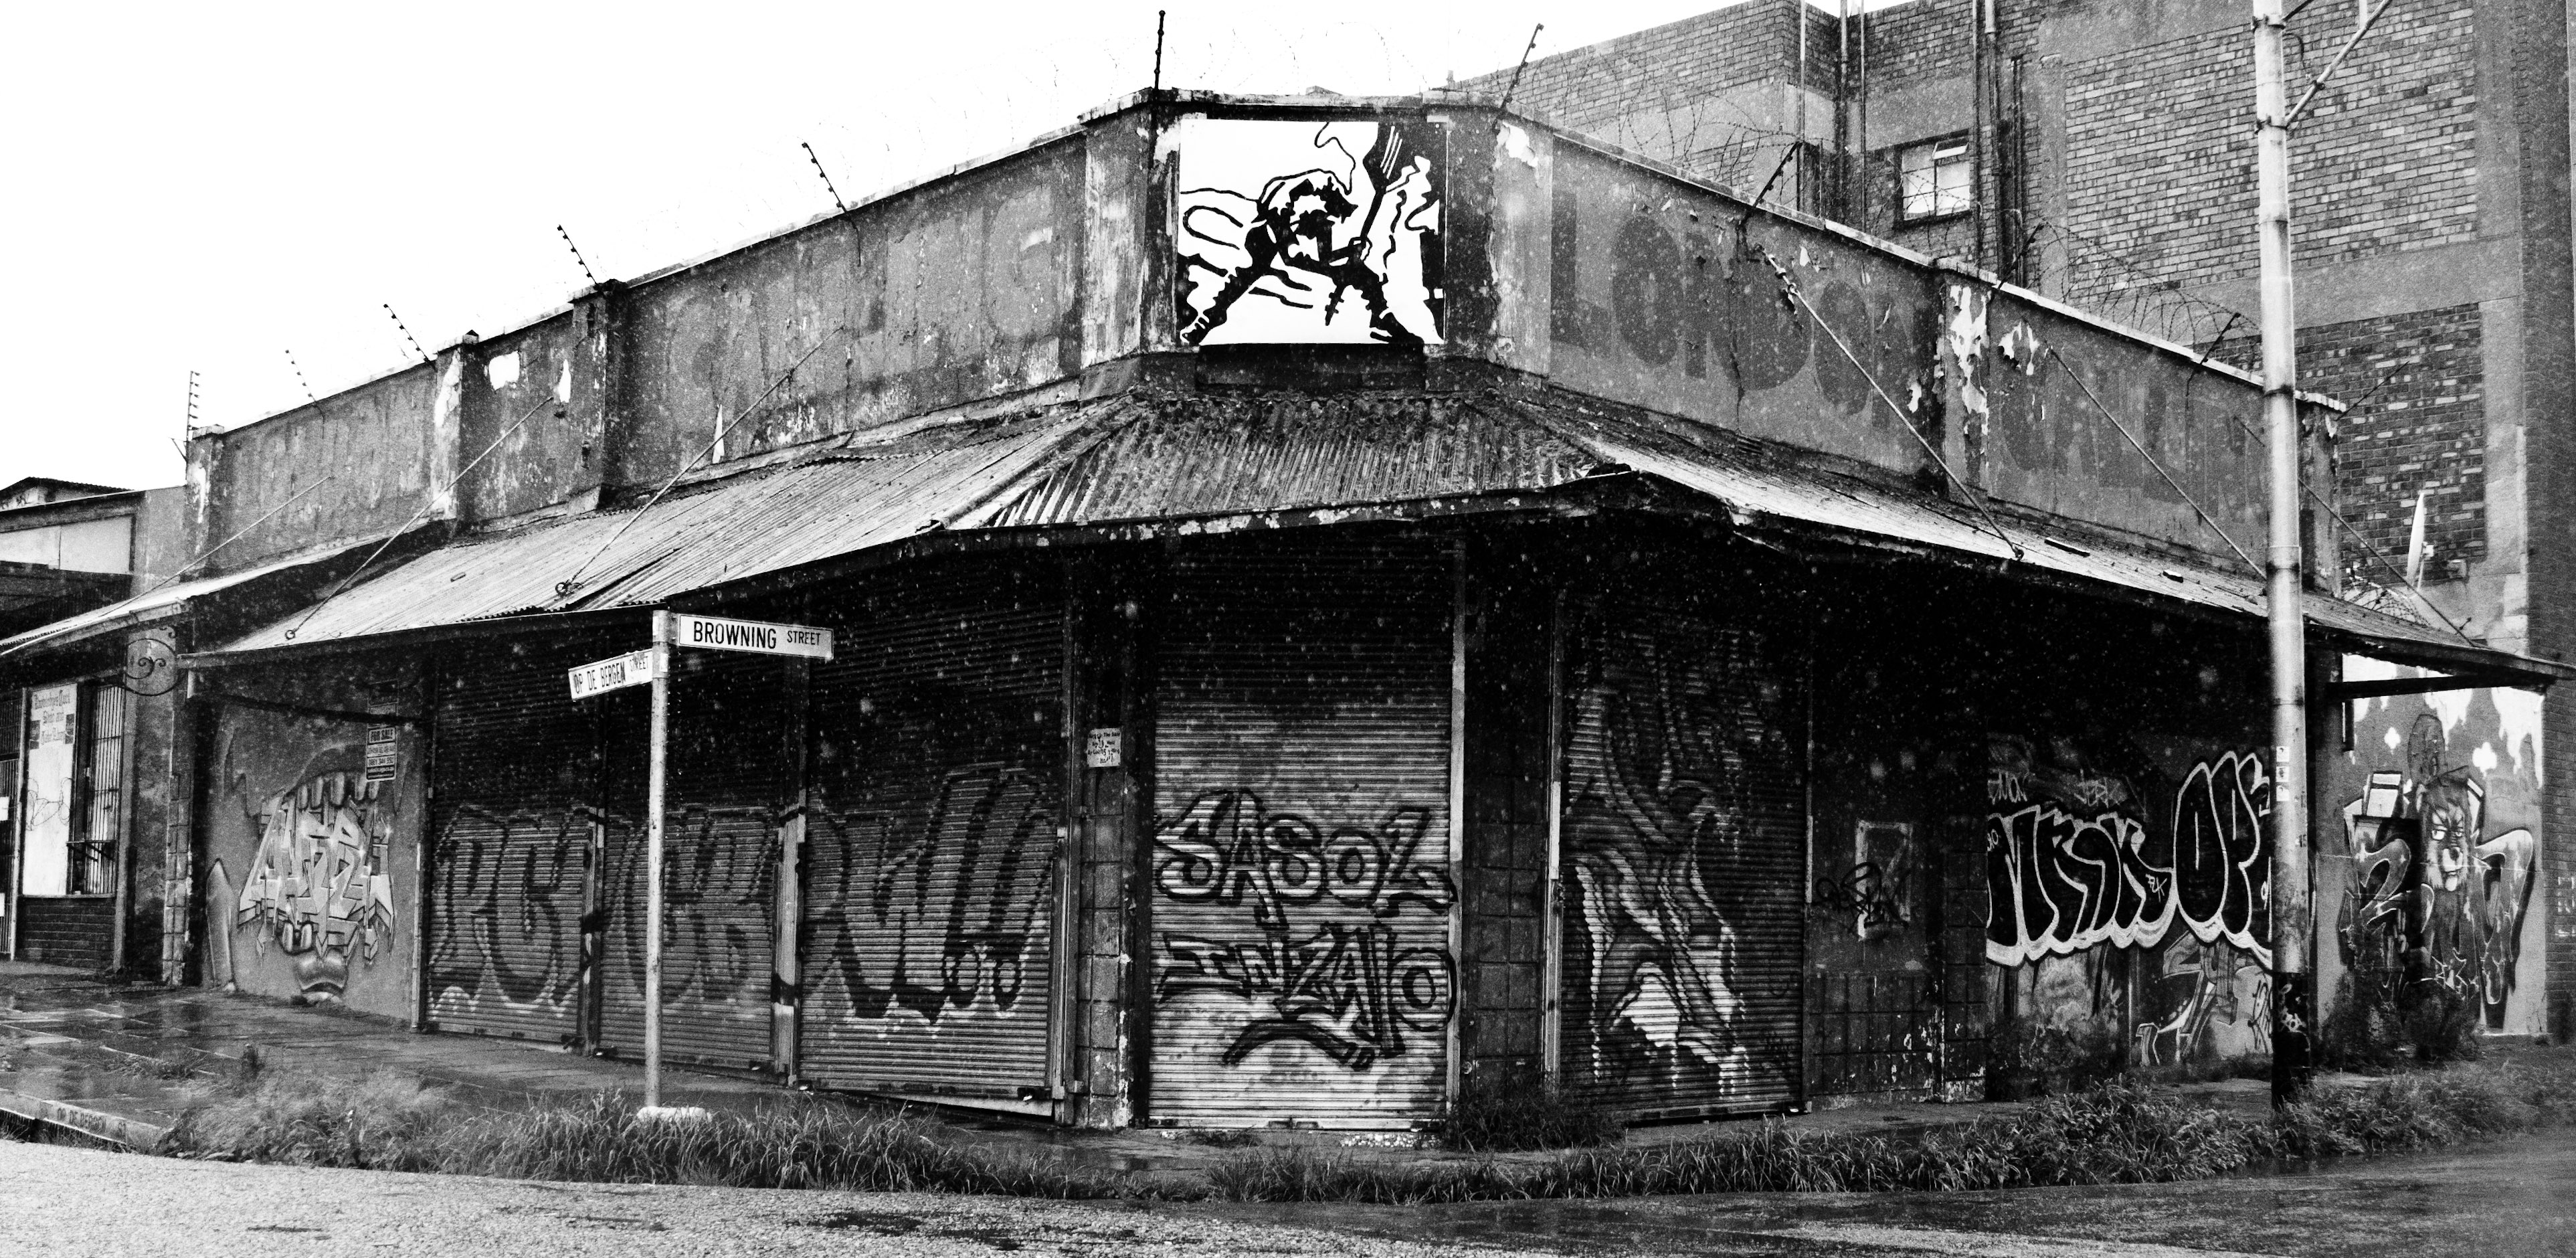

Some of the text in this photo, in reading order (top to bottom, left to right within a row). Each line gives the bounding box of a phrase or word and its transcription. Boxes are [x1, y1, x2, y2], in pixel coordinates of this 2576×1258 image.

[694, 621, 821, 649] BROWNING STREET
[587, 670, 597, 691] DE
[600, 661, 626, 687] BERGEN
[371, 728, 393, 742] FOR SALE
